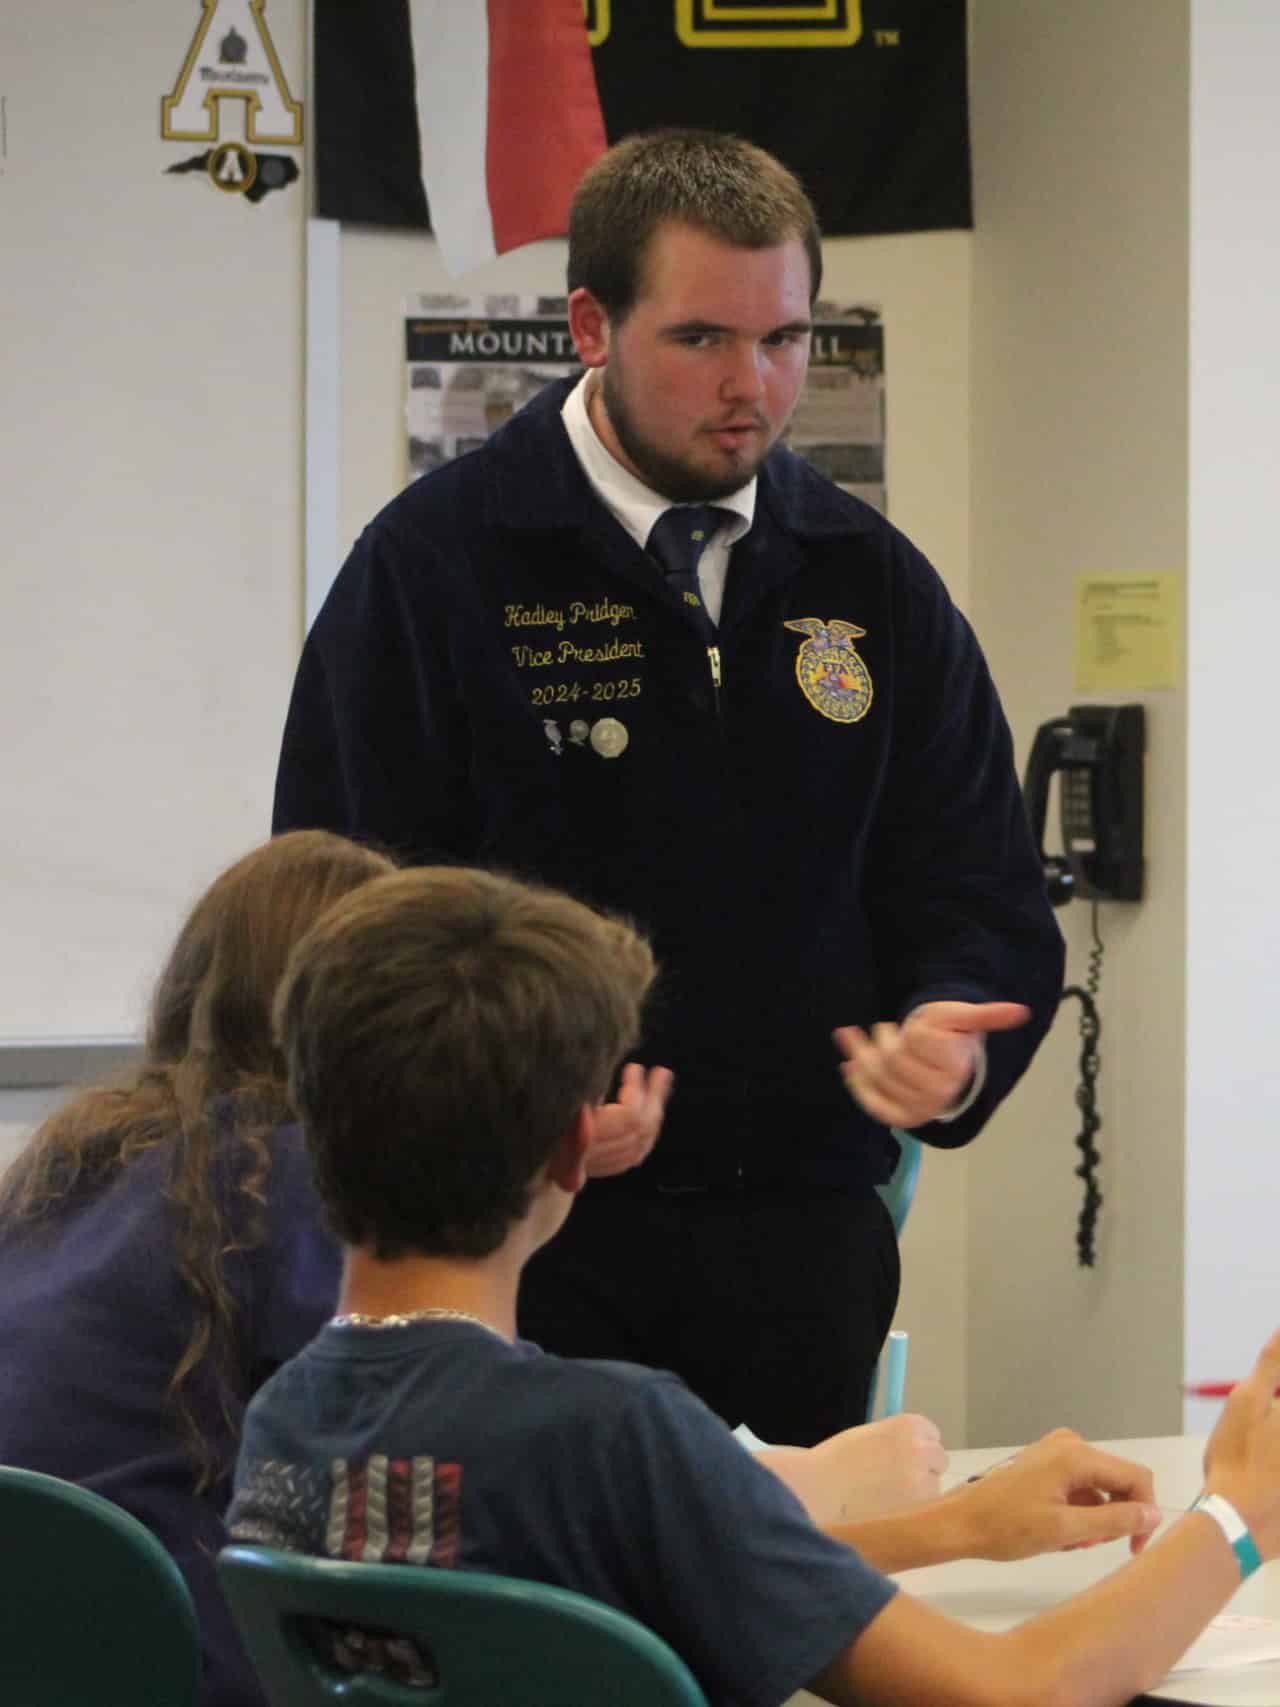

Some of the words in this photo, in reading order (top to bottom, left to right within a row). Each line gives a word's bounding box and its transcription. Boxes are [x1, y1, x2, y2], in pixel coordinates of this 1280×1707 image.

[504, 602, 565, 632] Hadley
[511, 645, 554, 668] Vice
[557, 637, 645, 664] President
[531, 677, 642, 705] 2024-2025
